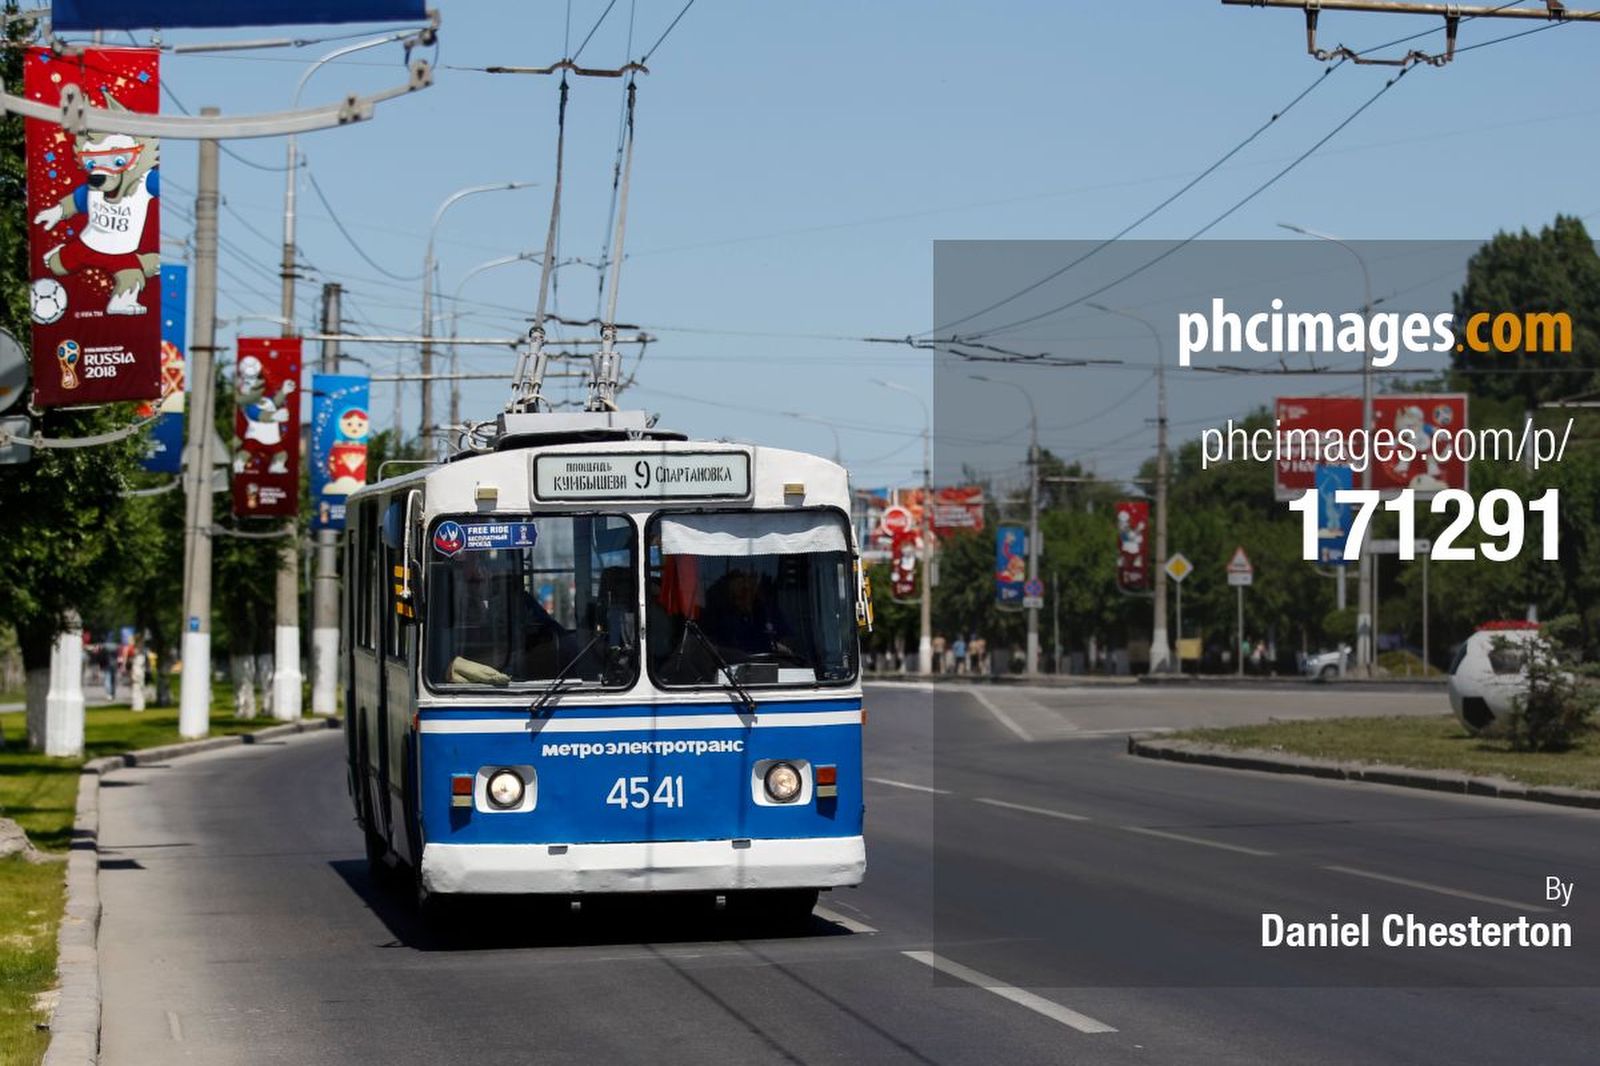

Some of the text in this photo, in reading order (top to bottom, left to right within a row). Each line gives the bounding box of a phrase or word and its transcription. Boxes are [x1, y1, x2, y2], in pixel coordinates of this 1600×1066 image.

[91, 211, 130, 232] 2018
[84, 352, 136, 366] RUSSIA
[85, 365, 117, 379] 2018
[634, 460, 651, 489] 9
[490, 525, 510, 533] RIDE
[541, 739, 744, 759] метроэлектротранс
[606, 776, 684, 809] 4541
